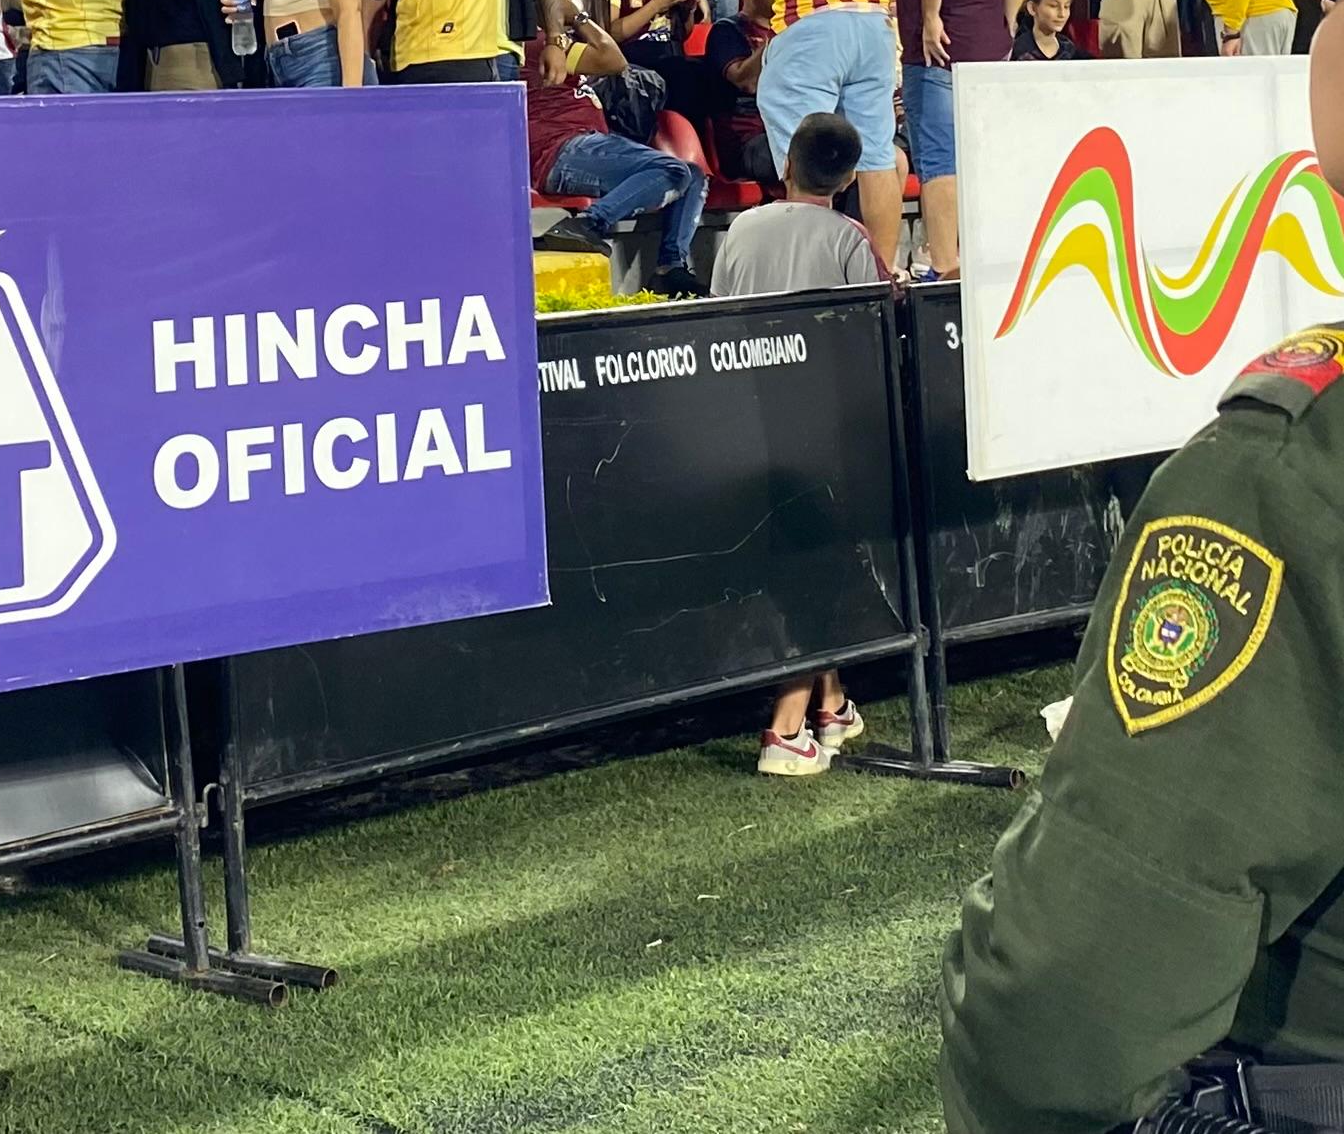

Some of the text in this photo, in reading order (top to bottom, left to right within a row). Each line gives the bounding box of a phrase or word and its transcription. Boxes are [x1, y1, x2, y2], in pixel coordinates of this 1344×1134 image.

[153, 295, 506, 393] HINCHA
[595, 344, 697, 387] FOLCLORICO
[710, 333, 808, 373] COLOMBIANO
[154, 403, 512, 510] OFICIAL
[1140, 556, 1253, 616] NACIONAL
[1118, 672, 1184, 707] COLOMBIA
